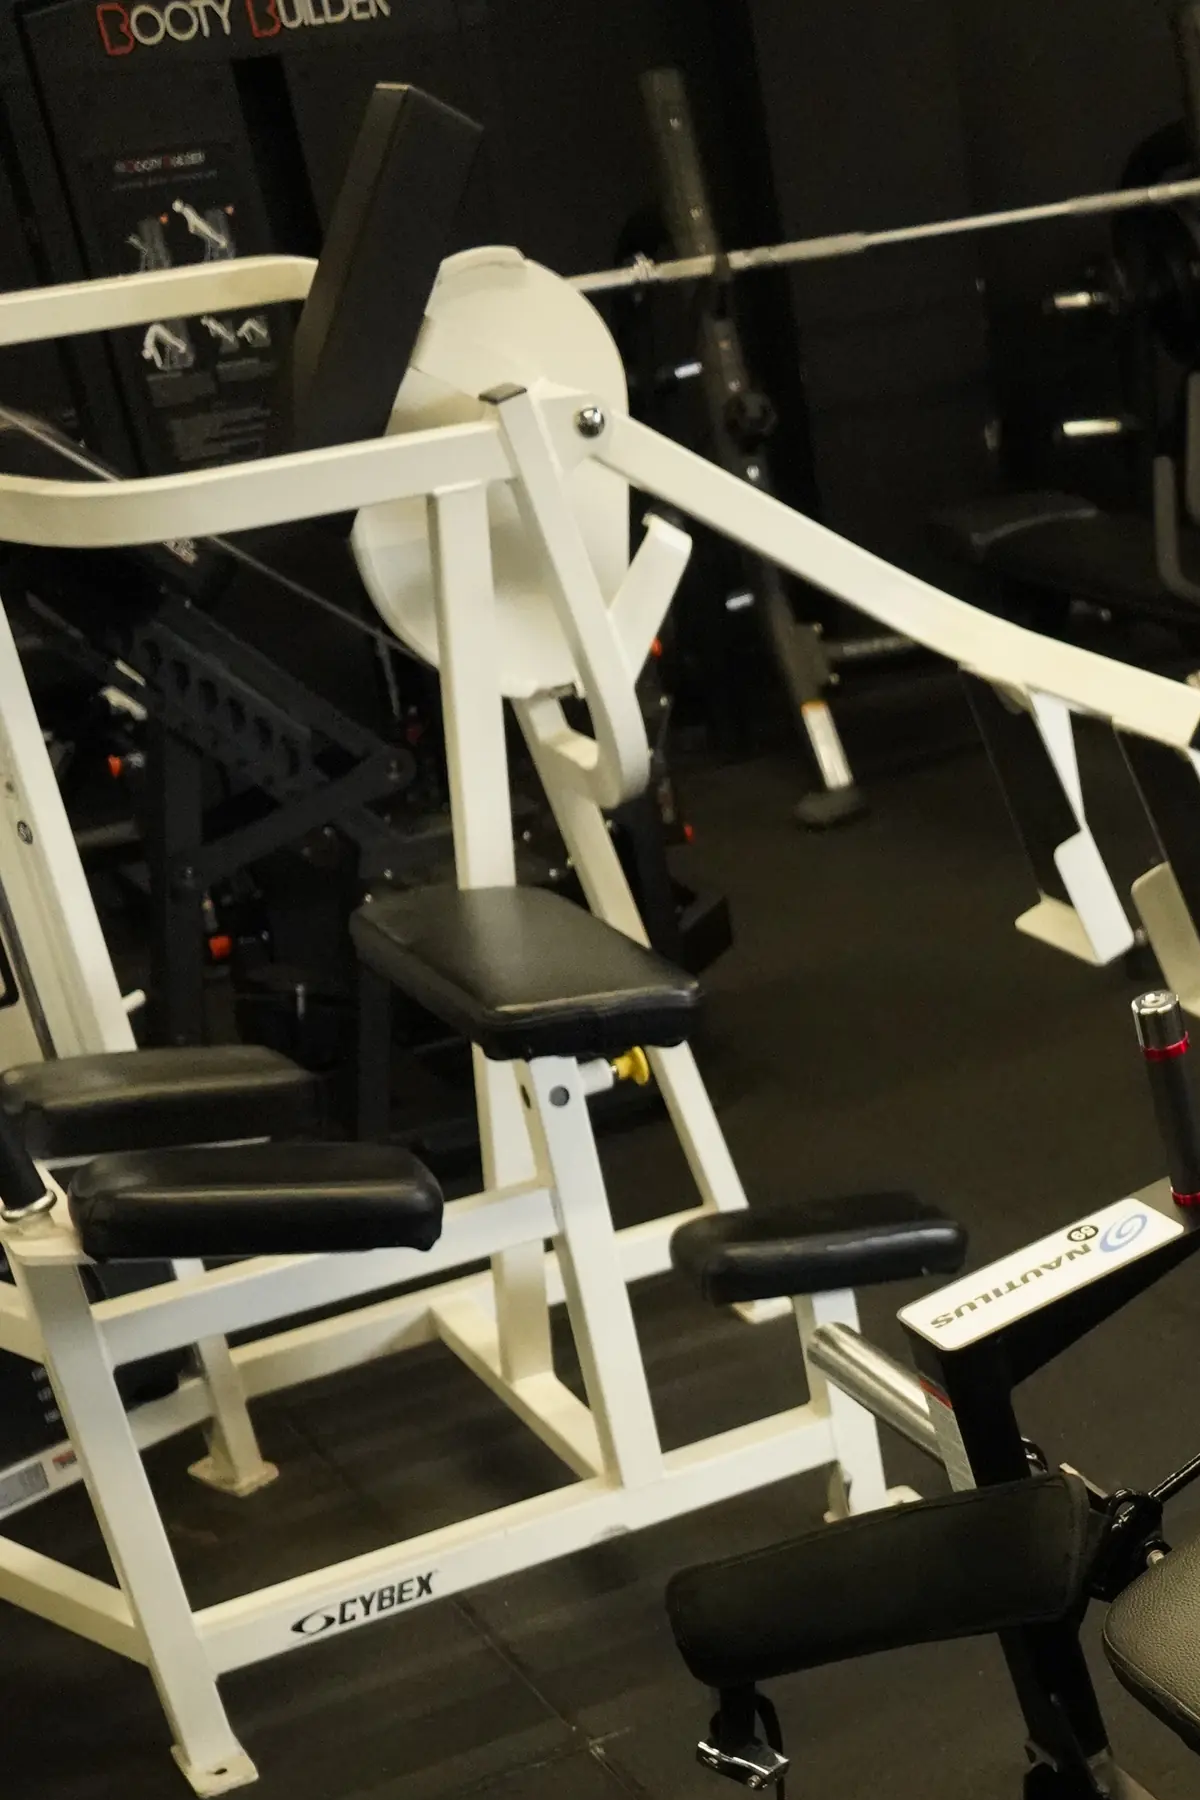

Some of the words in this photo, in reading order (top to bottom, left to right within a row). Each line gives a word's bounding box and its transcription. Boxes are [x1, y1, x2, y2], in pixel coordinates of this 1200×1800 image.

[96, 0, 232, 55] BOOTY
[930, 1243, 1092, 1329] NAUTILUS
[339, 1571, 434, 1625] CYBEX
